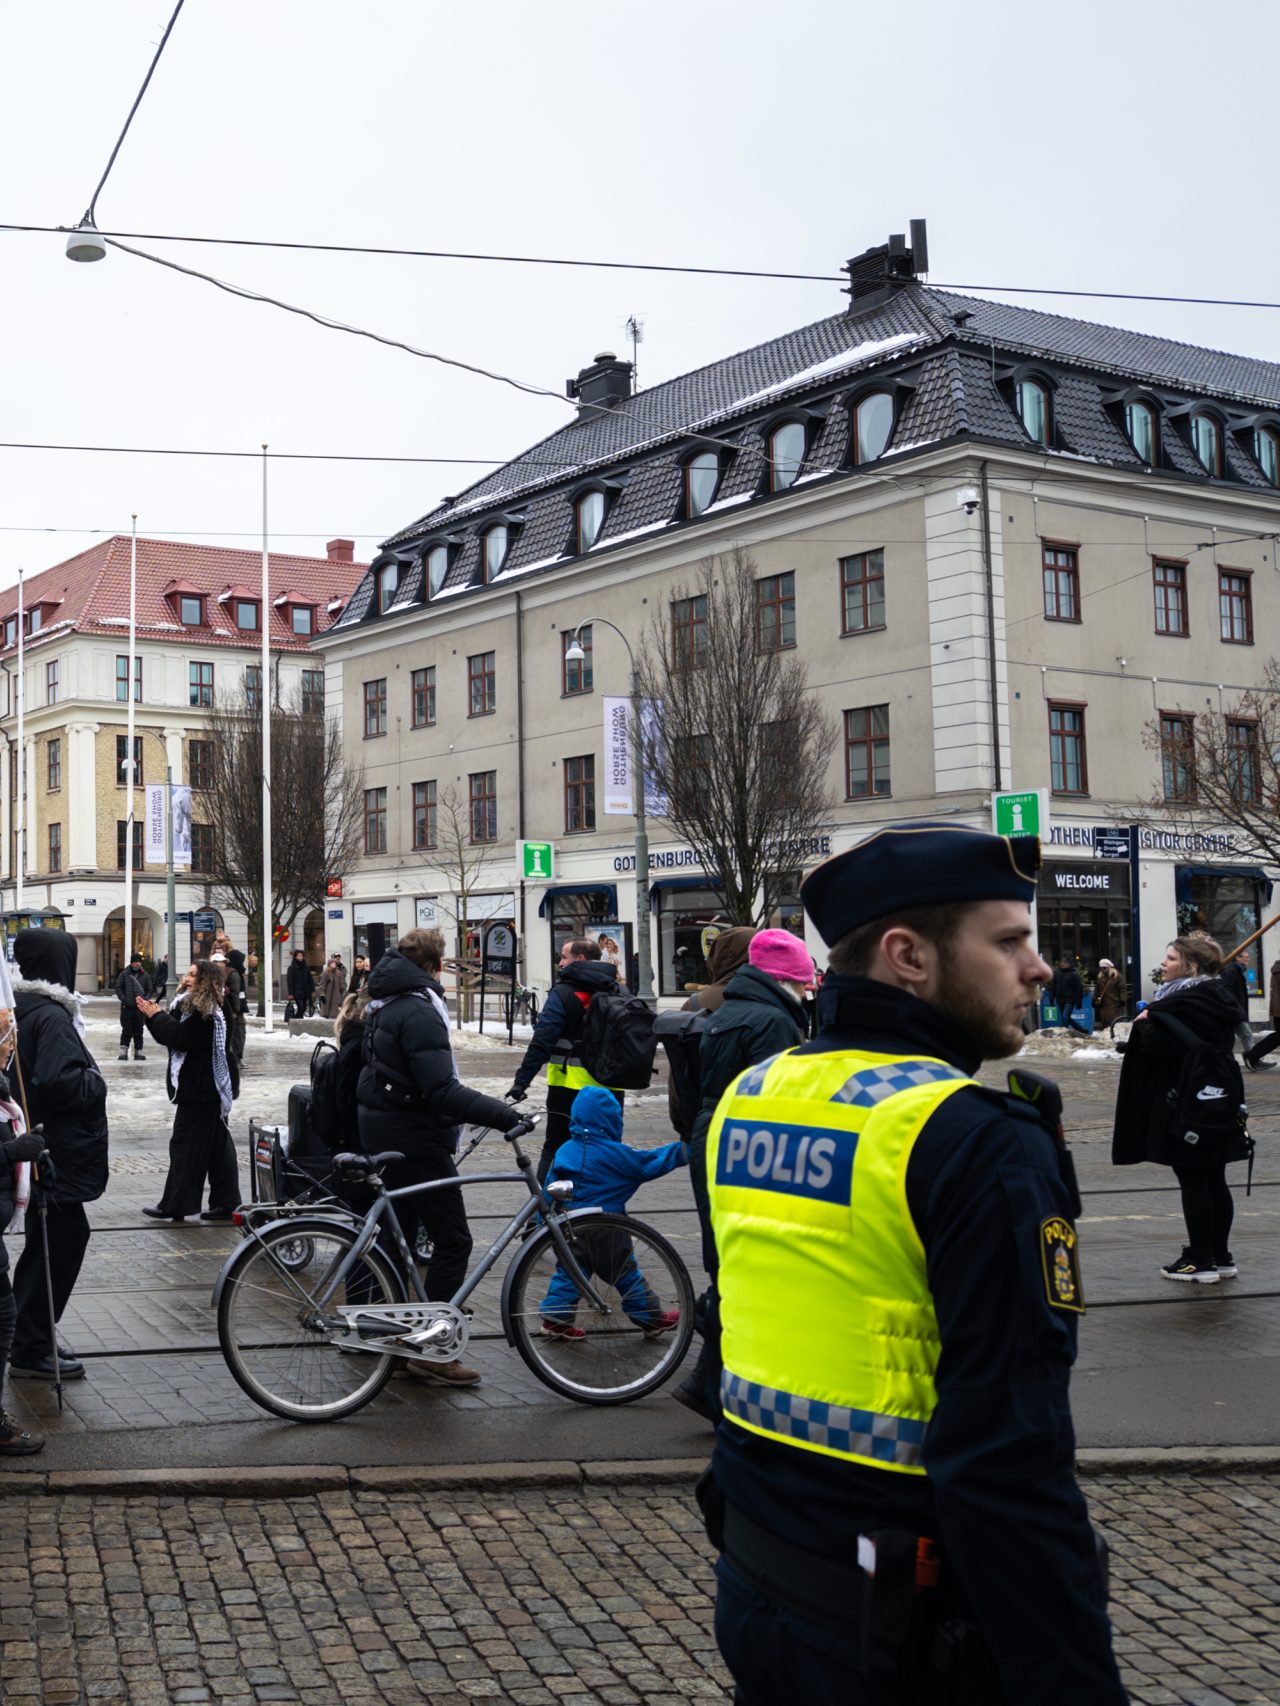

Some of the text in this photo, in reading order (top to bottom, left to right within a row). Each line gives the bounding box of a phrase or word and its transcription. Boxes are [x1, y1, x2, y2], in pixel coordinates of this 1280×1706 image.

[1001, 796, 1033, 805] TOURIST
[1138, 830, 1180, 850] ISITOR
[614, 849, 703, 871] GOTENBURG
[1055, 874, 1110, 889] WELCOME
[1202, 1085, 1225, 1096] NIKE
[725, 1127, 837, 1189] POLIS
[1044, 1222, 1075, 1249] POLIS
